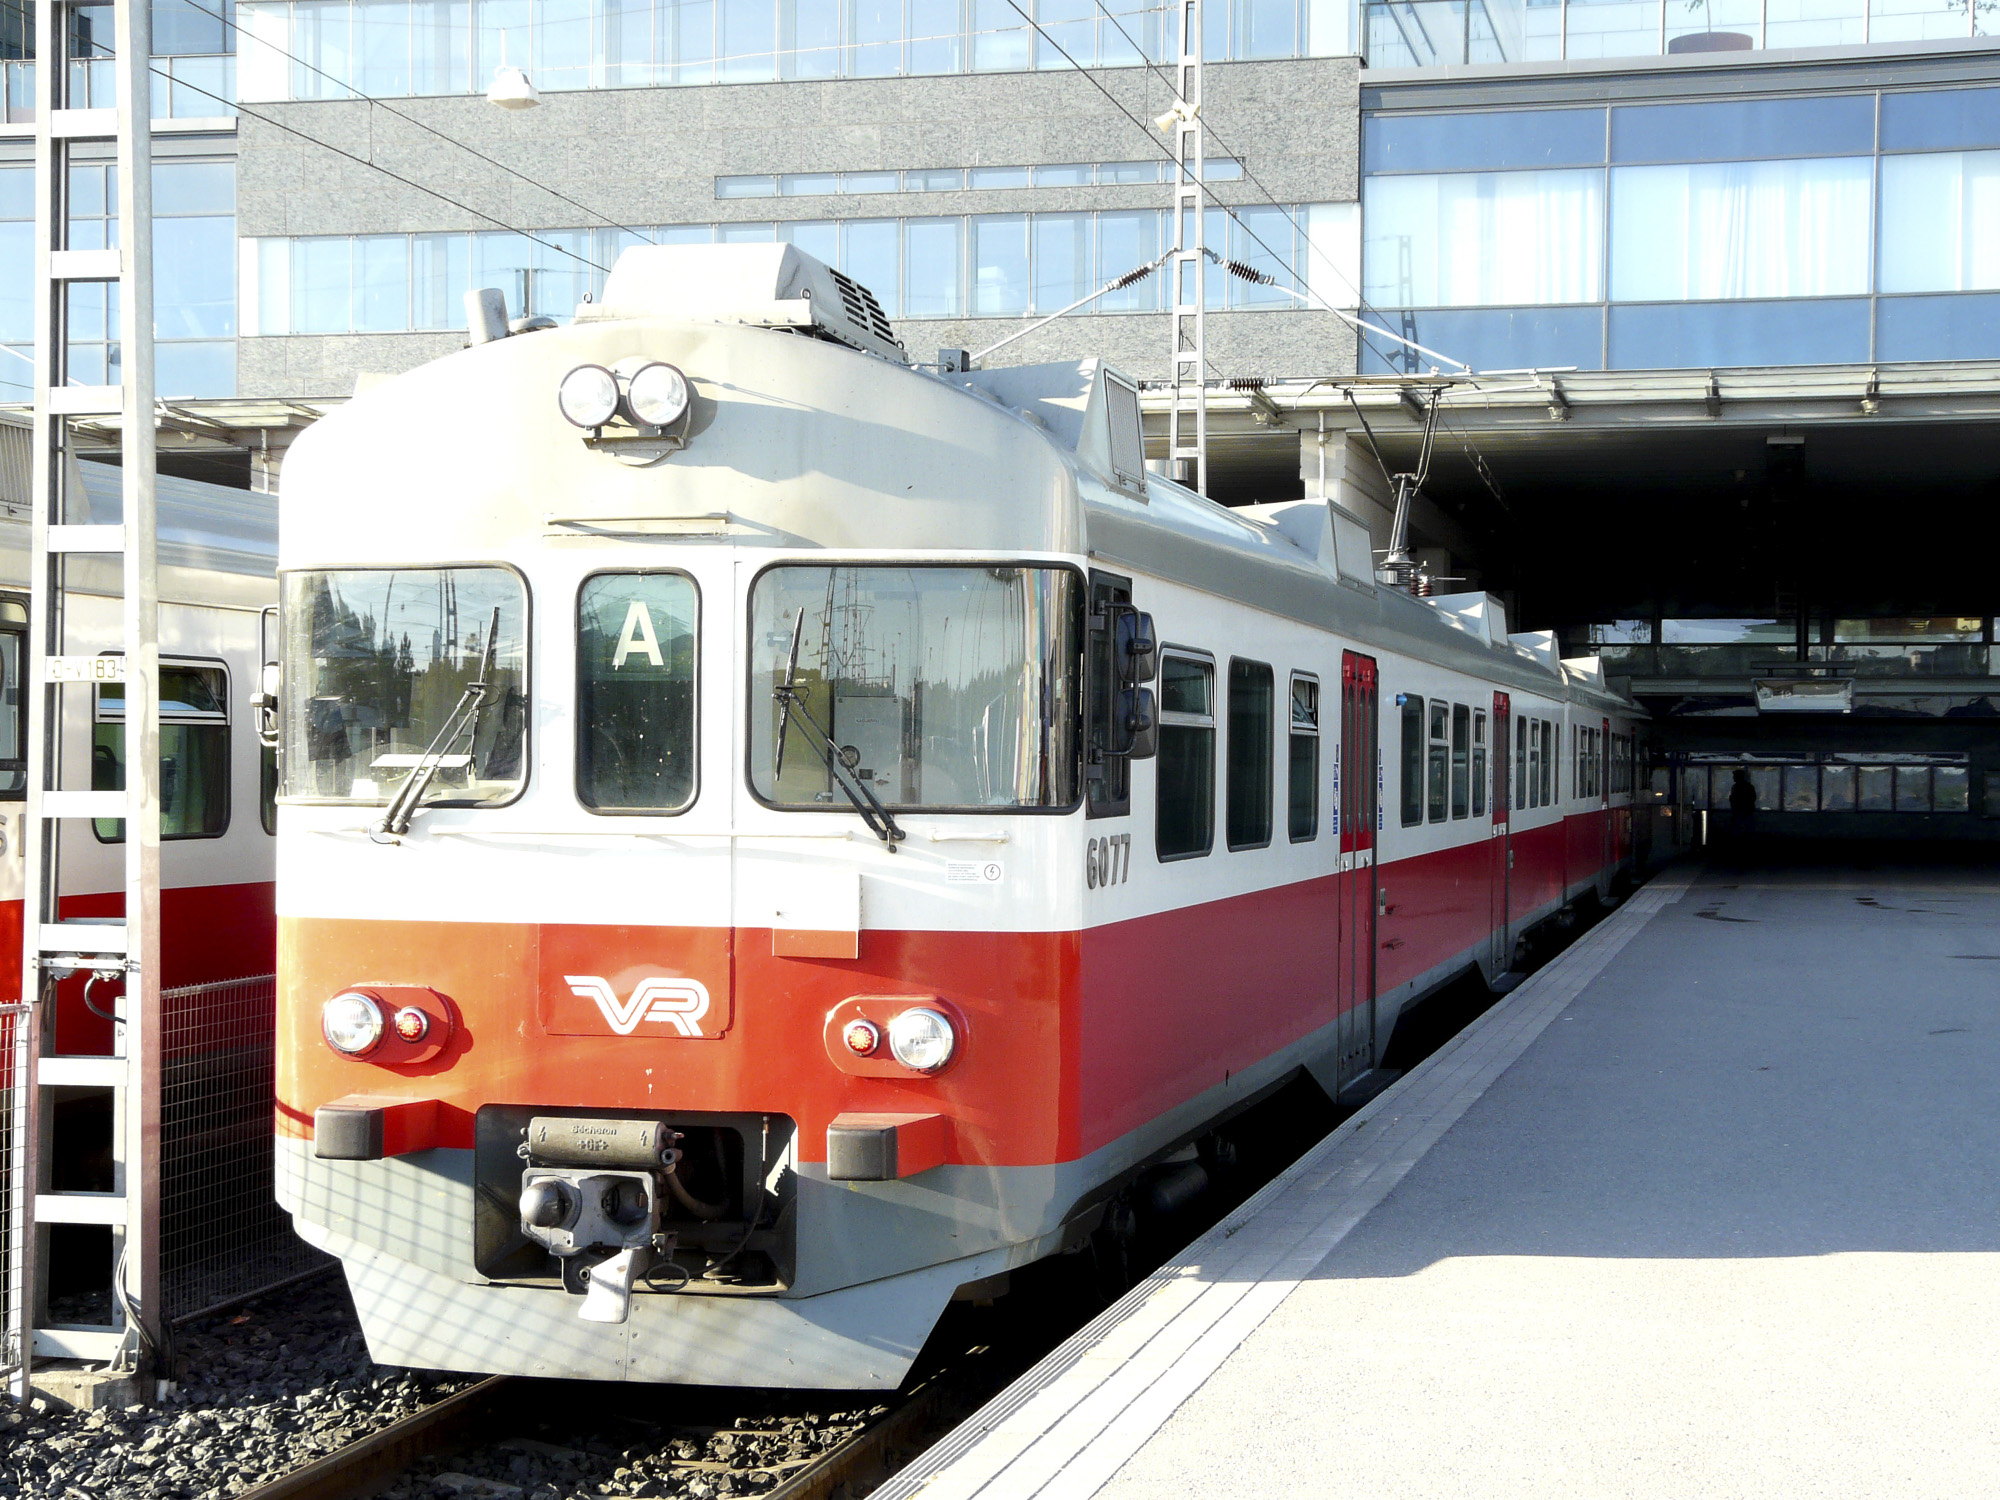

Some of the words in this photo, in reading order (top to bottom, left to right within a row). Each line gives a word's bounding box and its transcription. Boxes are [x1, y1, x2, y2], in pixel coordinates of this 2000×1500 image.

[612, 601, 664, 666] A
[1087, 833, 1131, 890] 6077
[564, 975, 710, 1036] VR
